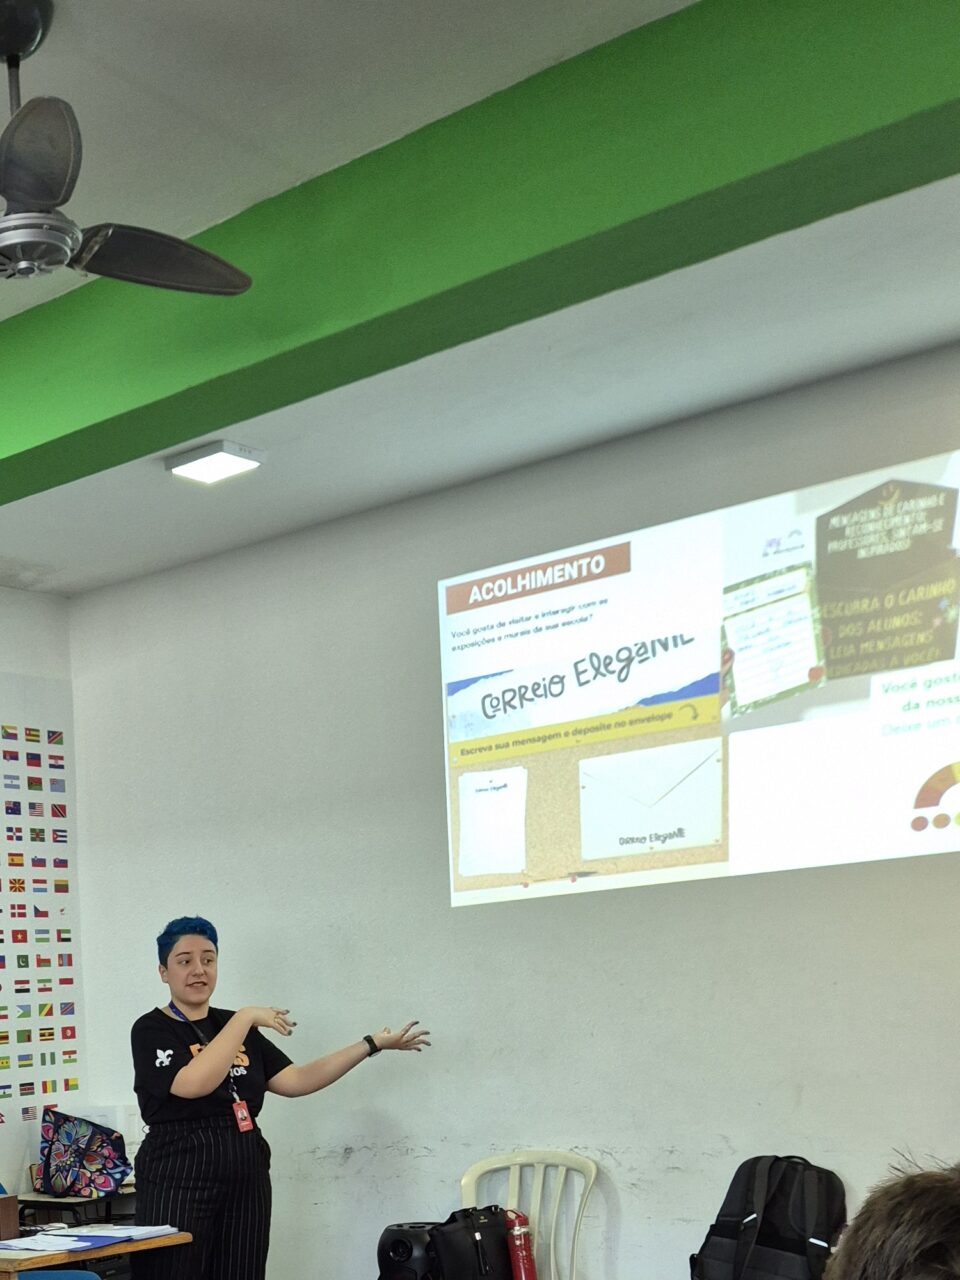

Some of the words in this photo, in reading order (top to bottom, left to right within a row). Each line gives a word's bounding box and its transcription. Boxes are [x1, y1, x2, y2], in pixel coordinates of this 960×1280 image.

[469, 554, 606, 604] ACOLHIMENTO
[899, 578, 957, 606] CARINHO
[451, 628, 471, 640] Você
[472, 624, 495, 636] gosta
[496, 618, 506, 629] de
[508, 614, 532, 626] visitar
[541, 605, 576, 619] interagir
[578, 601, 597, 610] com
[451, 637, 496, 653] exposições
[504, 629, 532, 641] murais
[545, 622, 560, 631] sua
[561, 613, 594, 627] escola?
[924, 672, 960, 692] gost
[902, 698, 920, 712] da
[460, 743, 493, 757] Escreva
[494, 741, 510, 751] sua
[512, 731, 562, 749] mensagem
[571, 721, 612, 738] deposite
[614, 718, 626, 729] no
[628, 711, 674, 728] envelope
